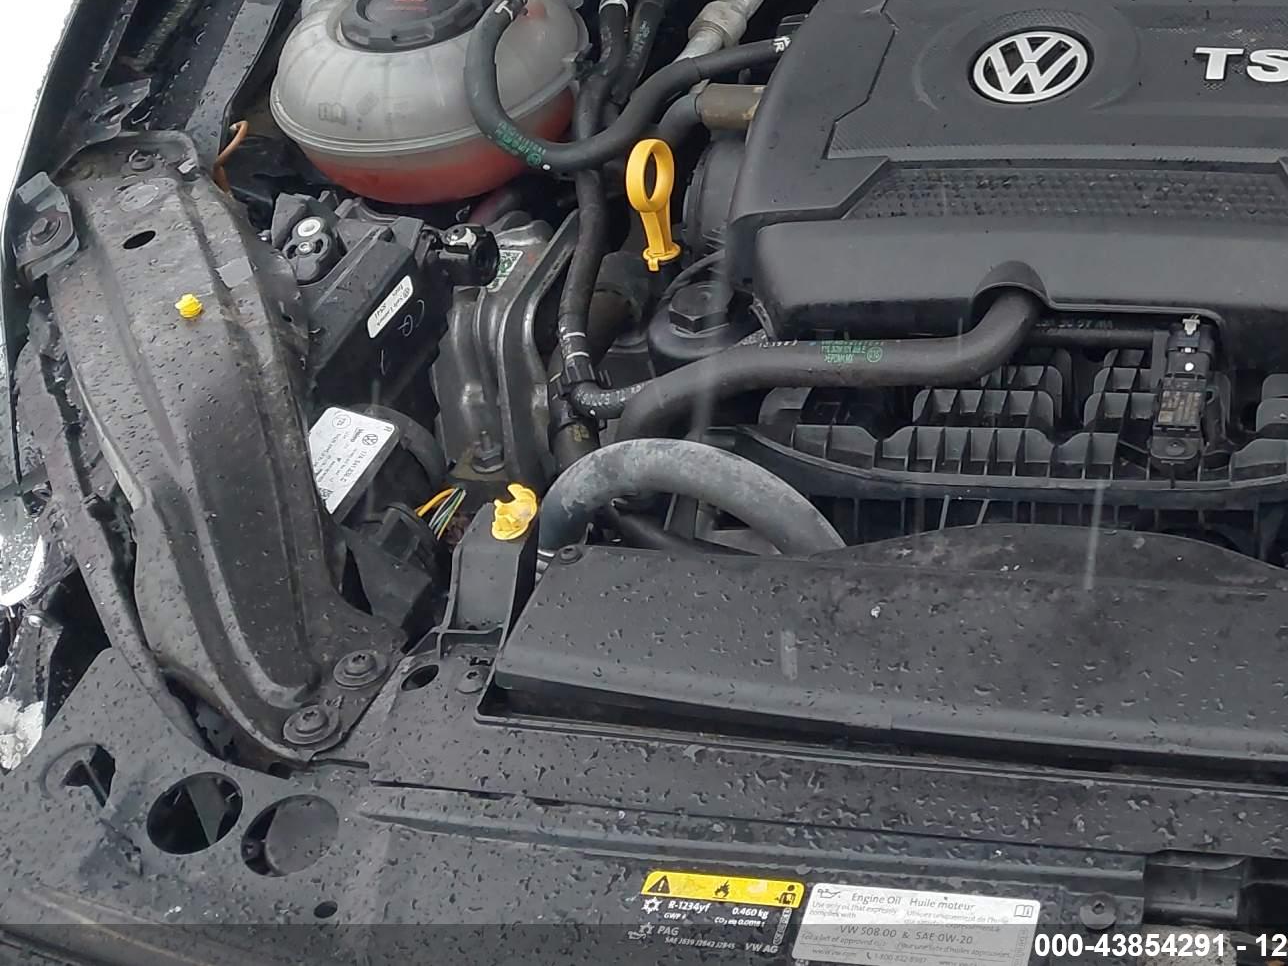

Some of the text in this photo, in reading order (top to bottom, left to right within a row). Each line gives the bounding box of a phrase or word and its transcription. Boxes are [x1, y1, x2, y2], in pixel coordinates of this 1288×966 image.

[851, 893, 977, 911] Engine Oil Huile moteur
[657, 925, 680, 936] PAG
[840, 925, 859, 934] VW
[915, 931, 935, 940] SAE
